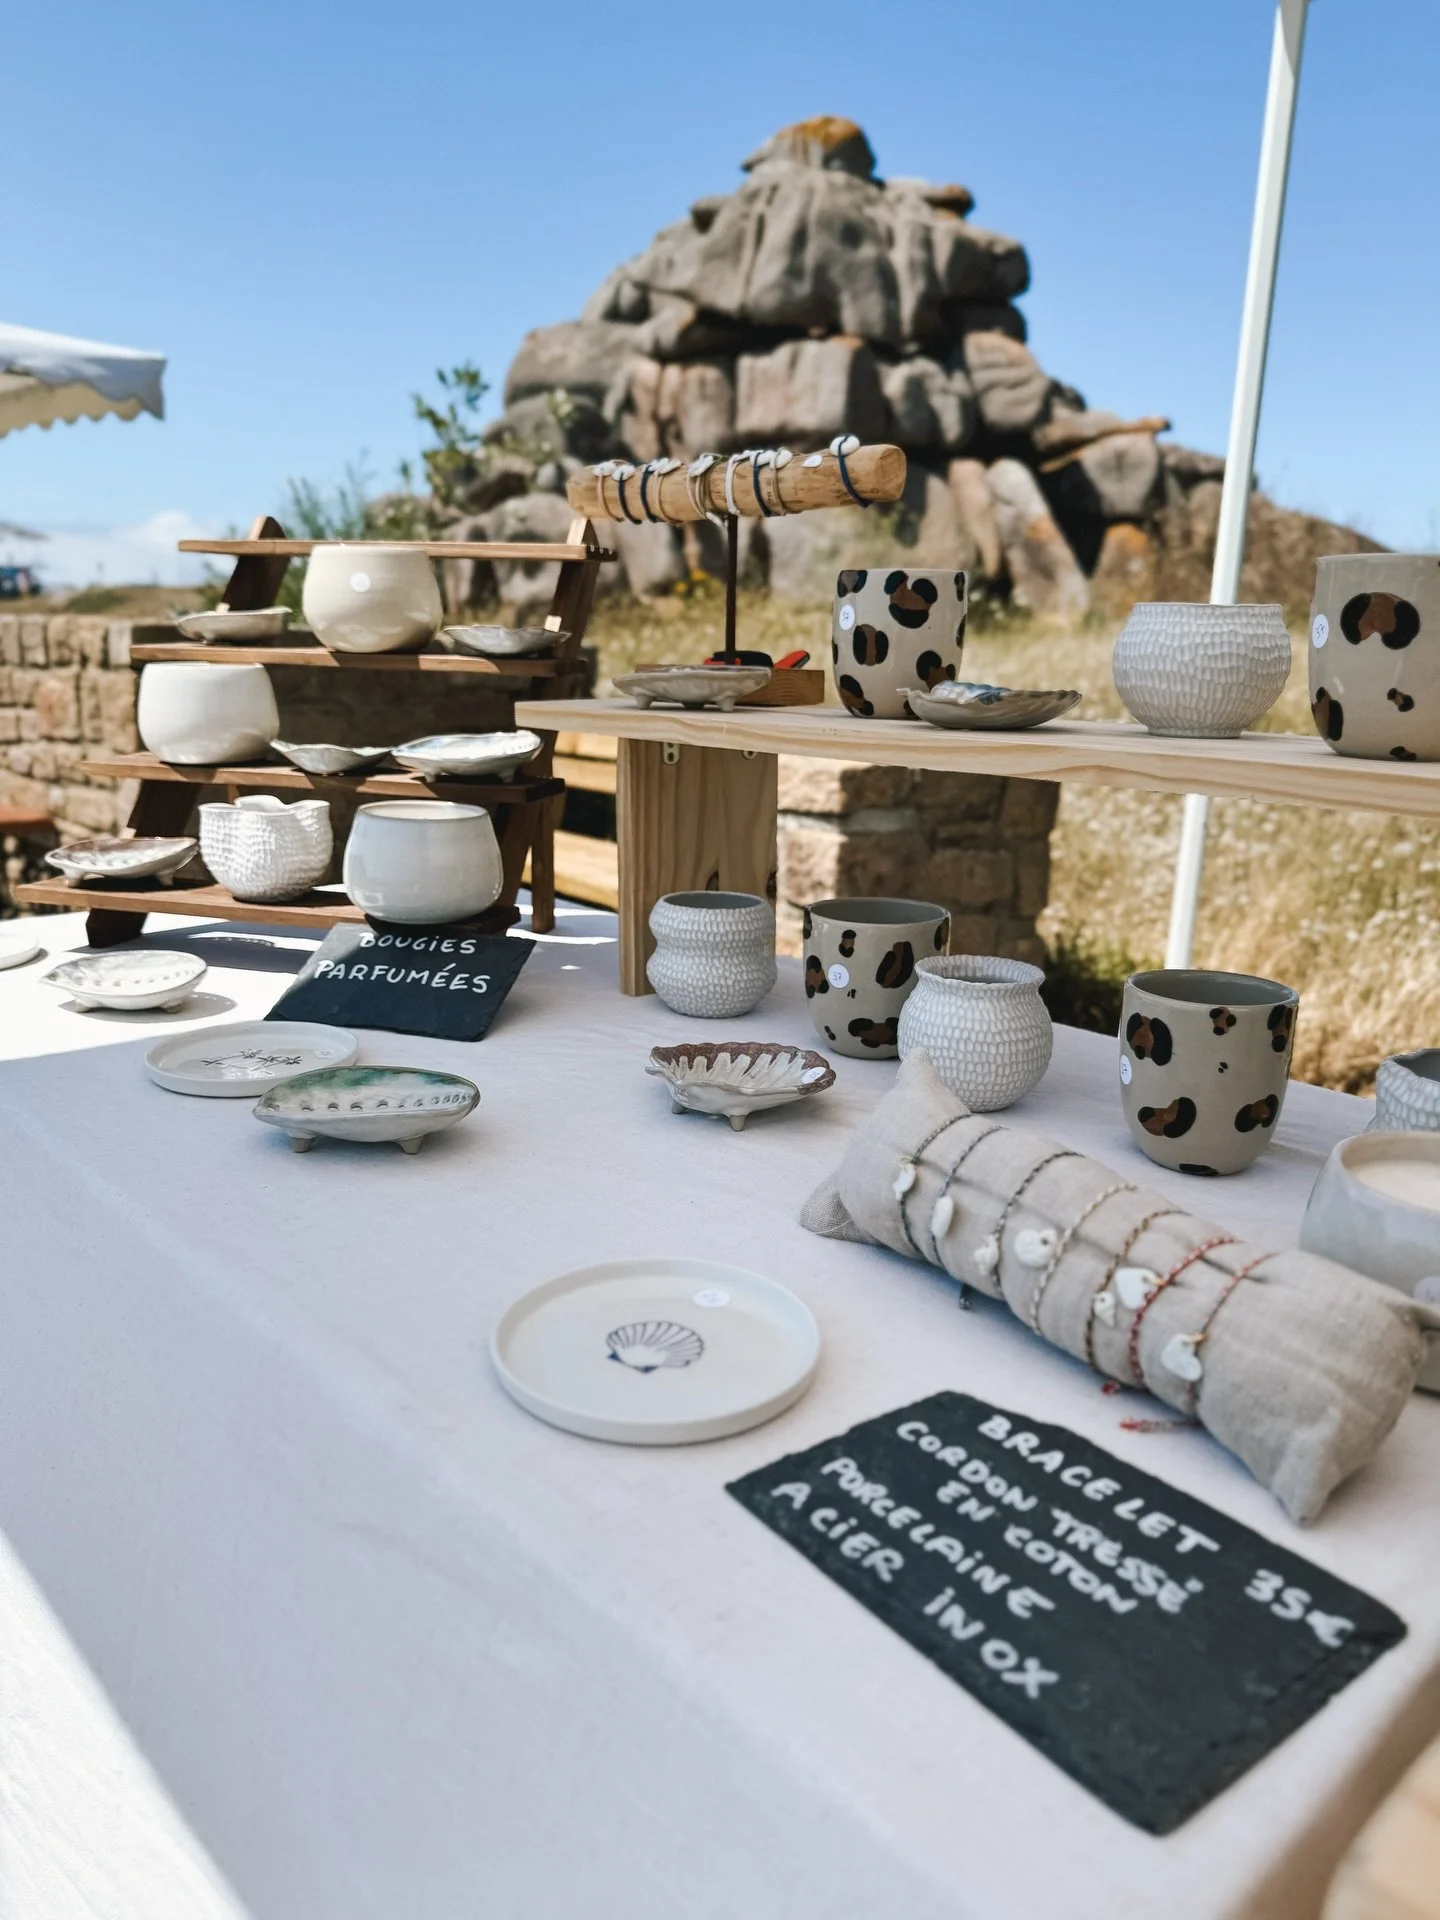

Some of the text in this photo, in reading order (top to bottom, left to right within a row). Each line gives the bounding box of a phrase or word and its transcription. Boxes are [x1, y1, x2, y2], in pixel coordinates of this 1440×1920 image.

[313, 959, 491, 993] PARFUMÉES
[897, 1421, 1037, 1511] CORDON
[936, 1480, 1137, 1614] EN COTON
[977, 1415, 1355, 1648] BRACELET 35€
